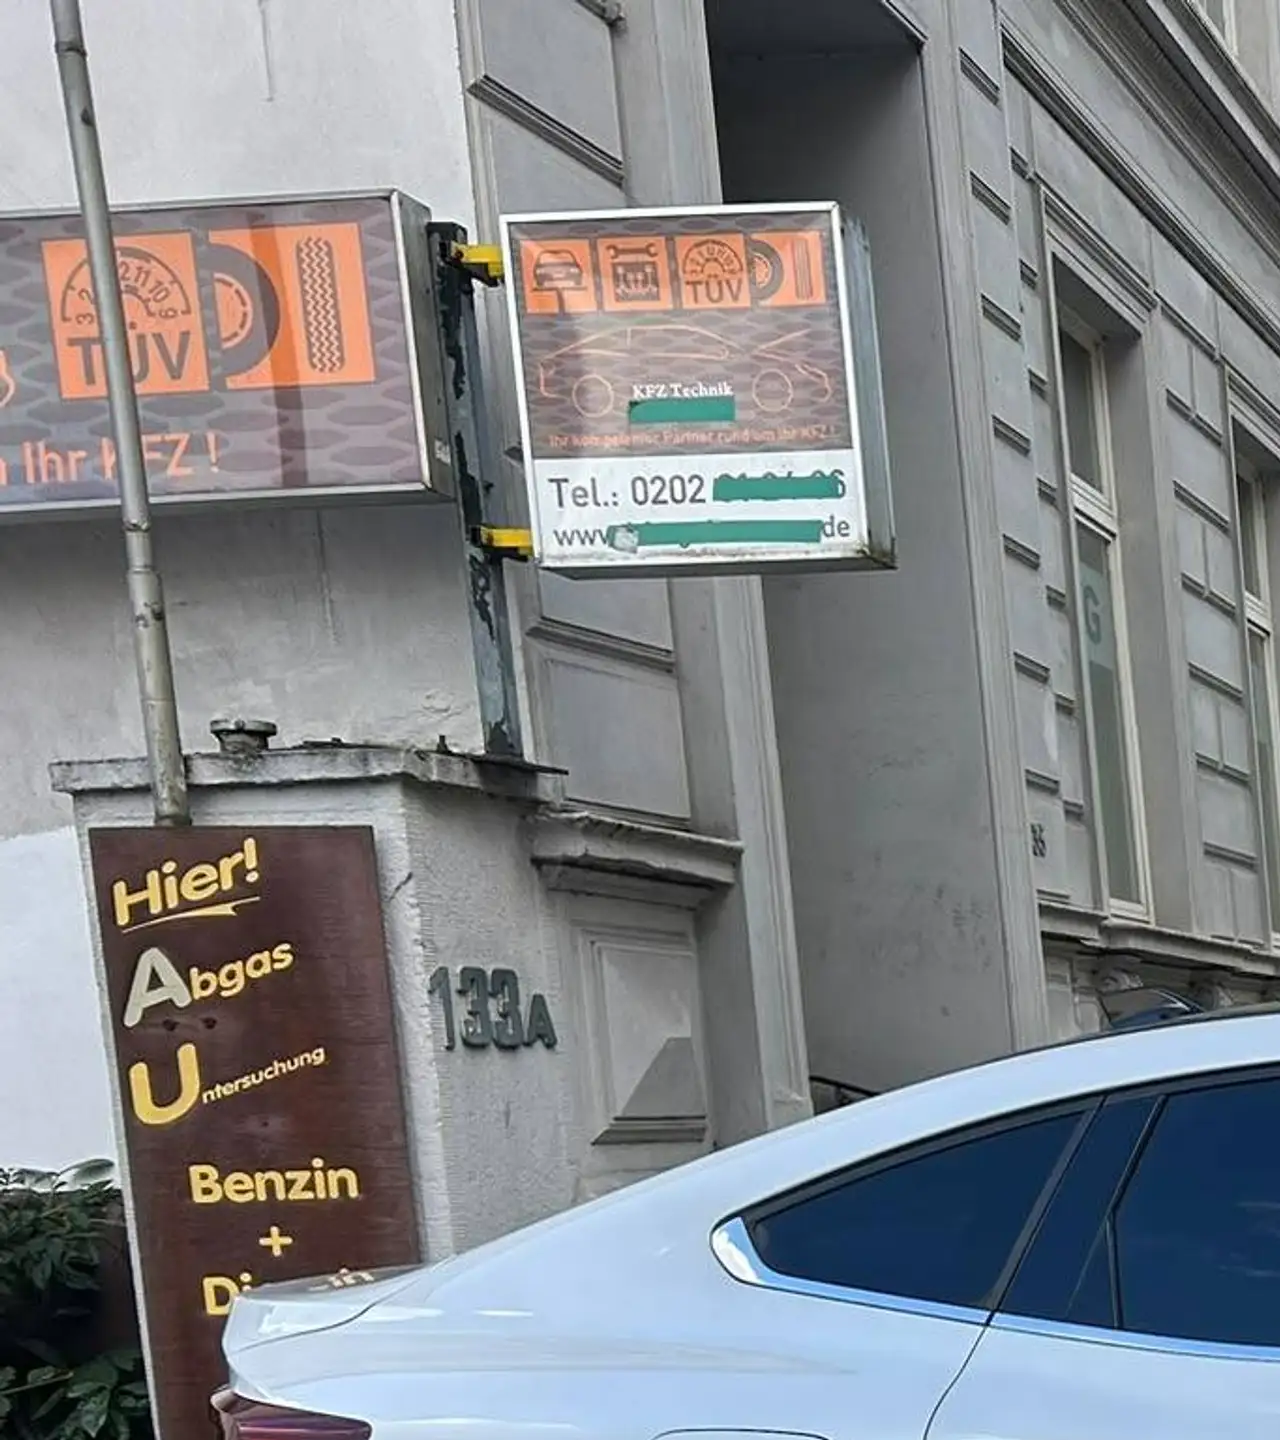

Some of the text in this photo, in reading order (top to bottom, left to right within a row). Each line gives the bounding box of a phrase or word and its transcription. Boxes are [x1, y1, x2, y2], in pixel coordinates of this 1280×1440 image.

[684, 273, 743, 304] TÜV
[631, 381, 734, 400] KFZ Technik
[22, 438, 88, 484] Ihr
[548, 477, 619, 508] Tel.:
[631, 474, 706, 506] 0202
[112, 837, 260, 927] Hier!
[122, 942, 295, 1027] Abgas
[427, 964, 558, 1051] 133A
[128, 1042, 326, 1125] Untersuchung
[188, 1157, 360, 1204] Benzin
